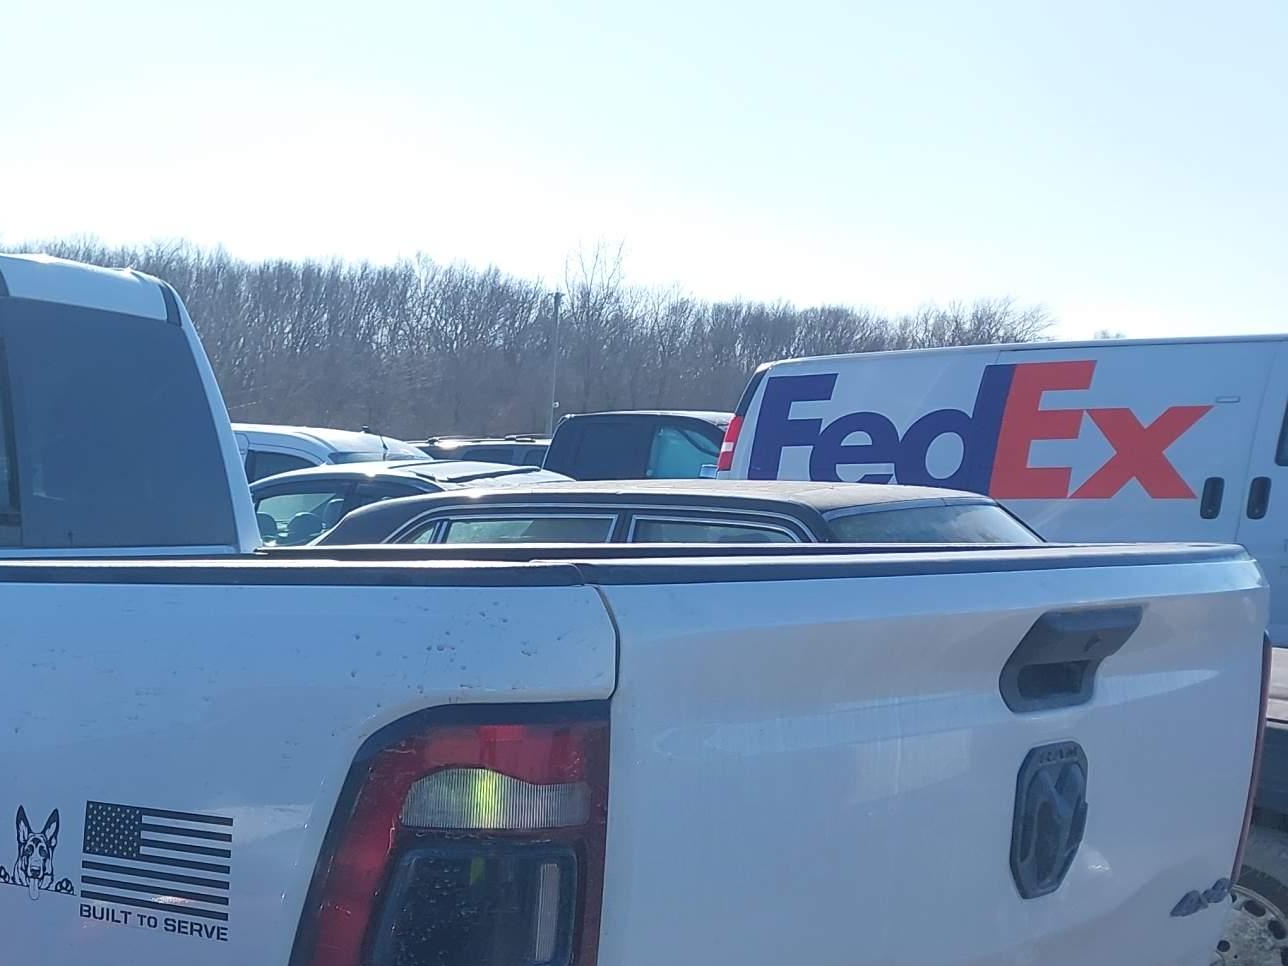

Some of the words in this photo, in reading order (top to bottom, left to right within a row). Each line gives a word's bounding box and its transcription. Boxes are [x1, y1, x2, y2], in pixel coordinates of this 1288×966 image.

[748, 360, 1213, 499] FedEx
[79, 903, 132, 925] BUILT
[137, 913, 158, 929] TO
[163, 917, 229, 942] SERVE
